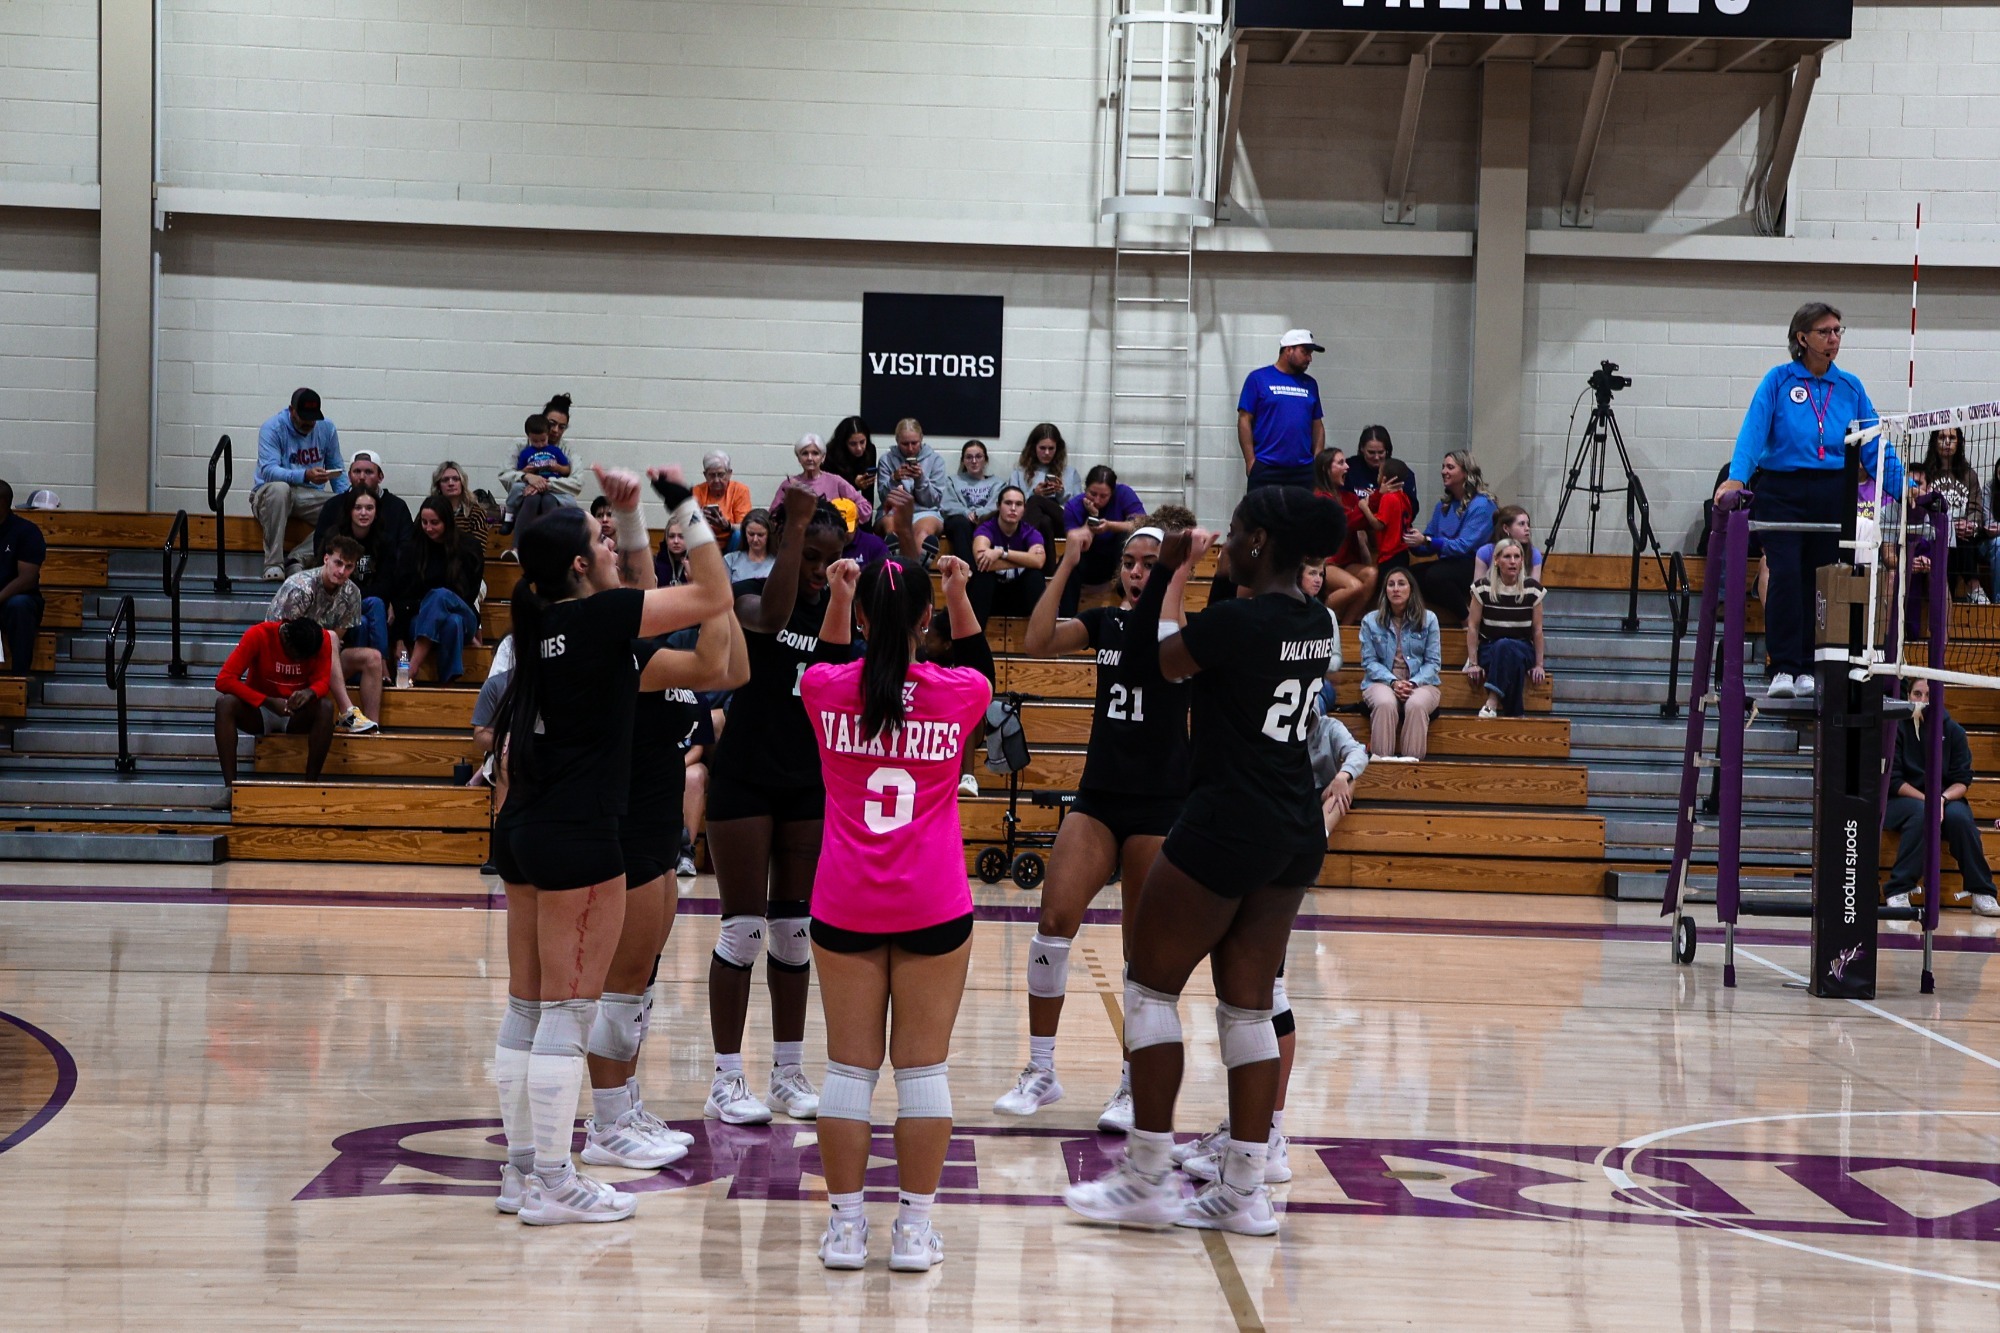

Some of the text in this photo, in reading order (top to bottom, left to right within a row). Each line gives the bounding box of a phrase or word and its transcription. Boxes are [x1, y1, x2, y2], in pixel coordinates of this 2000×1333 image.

[868, 352, 995, 378] VISITORS
[275, 661, 302, 675] STATE
[1279, 637, 1334, 662] VALKYRIES
[1106, 682, 1144, 722] 21
[1261, 676, 1323, 743] 20
[820, 710, 961, 761] VALKYRIES
[1842, 819, 1859, 924] sports imports
